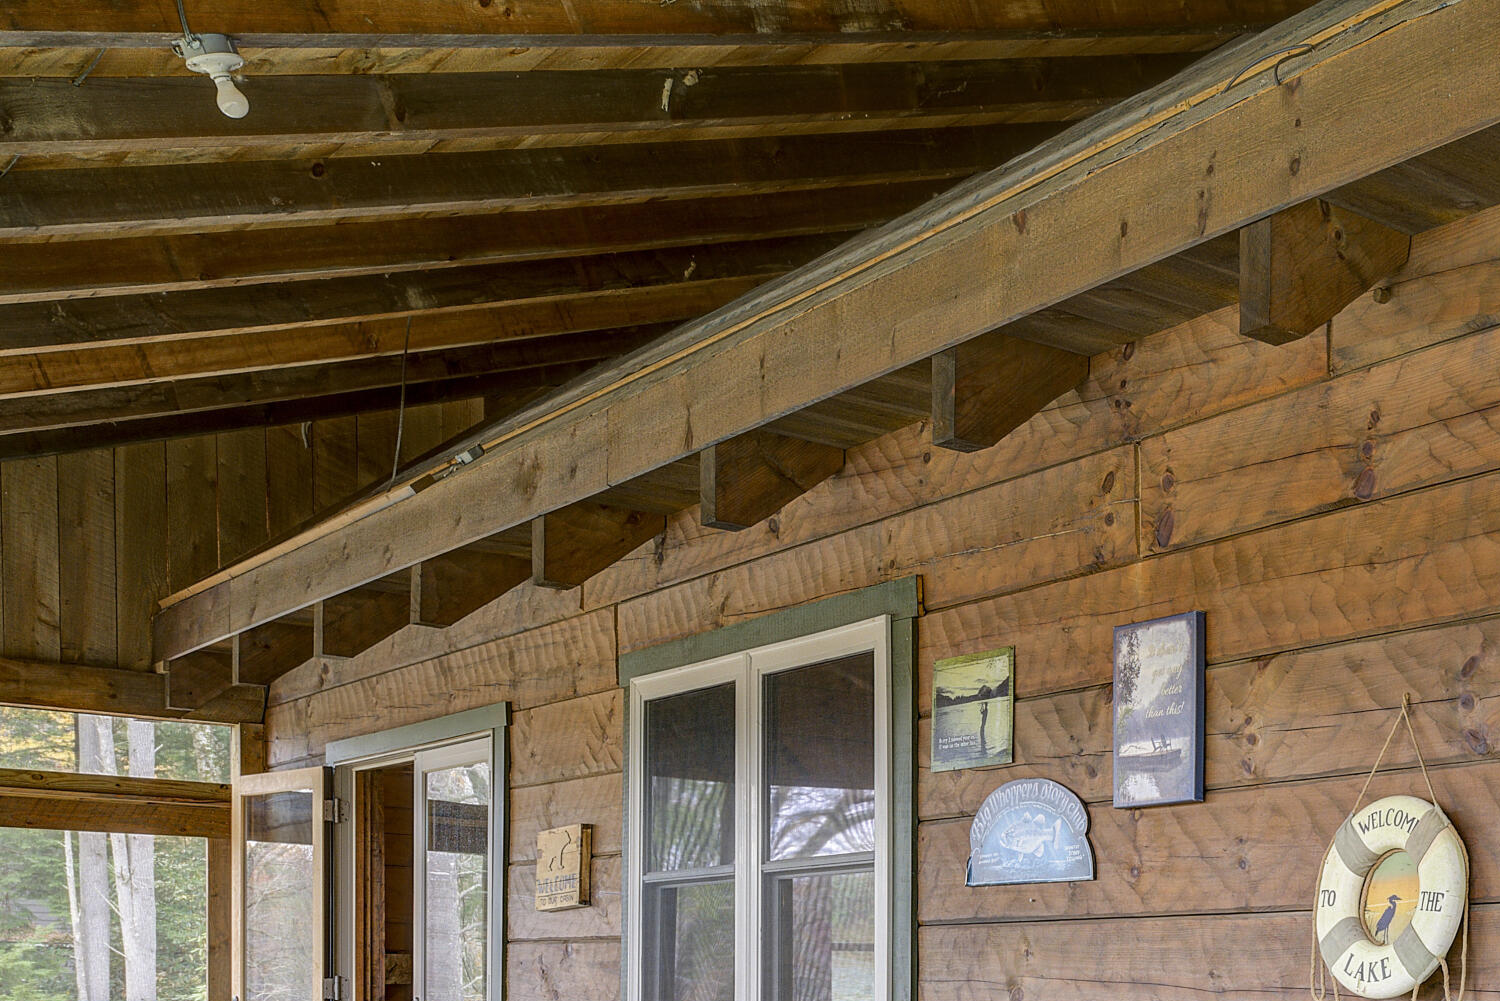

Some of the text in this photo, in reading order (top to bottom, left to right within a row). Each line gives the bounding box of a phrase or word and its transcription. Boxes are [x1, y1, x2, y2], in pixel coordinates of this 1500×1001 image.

[1161, 682, 1183, 696] better
[1145, 702, 1184, 718] than this!
[988, 782, 1040, 811] Whoppers
[1067, 803, 1086, 830] club
[537, 873, 577, 894] WELCOME
[1321, 889, 1445, 912] TO THE
[1343, 953, 1392, 983] LAKE
